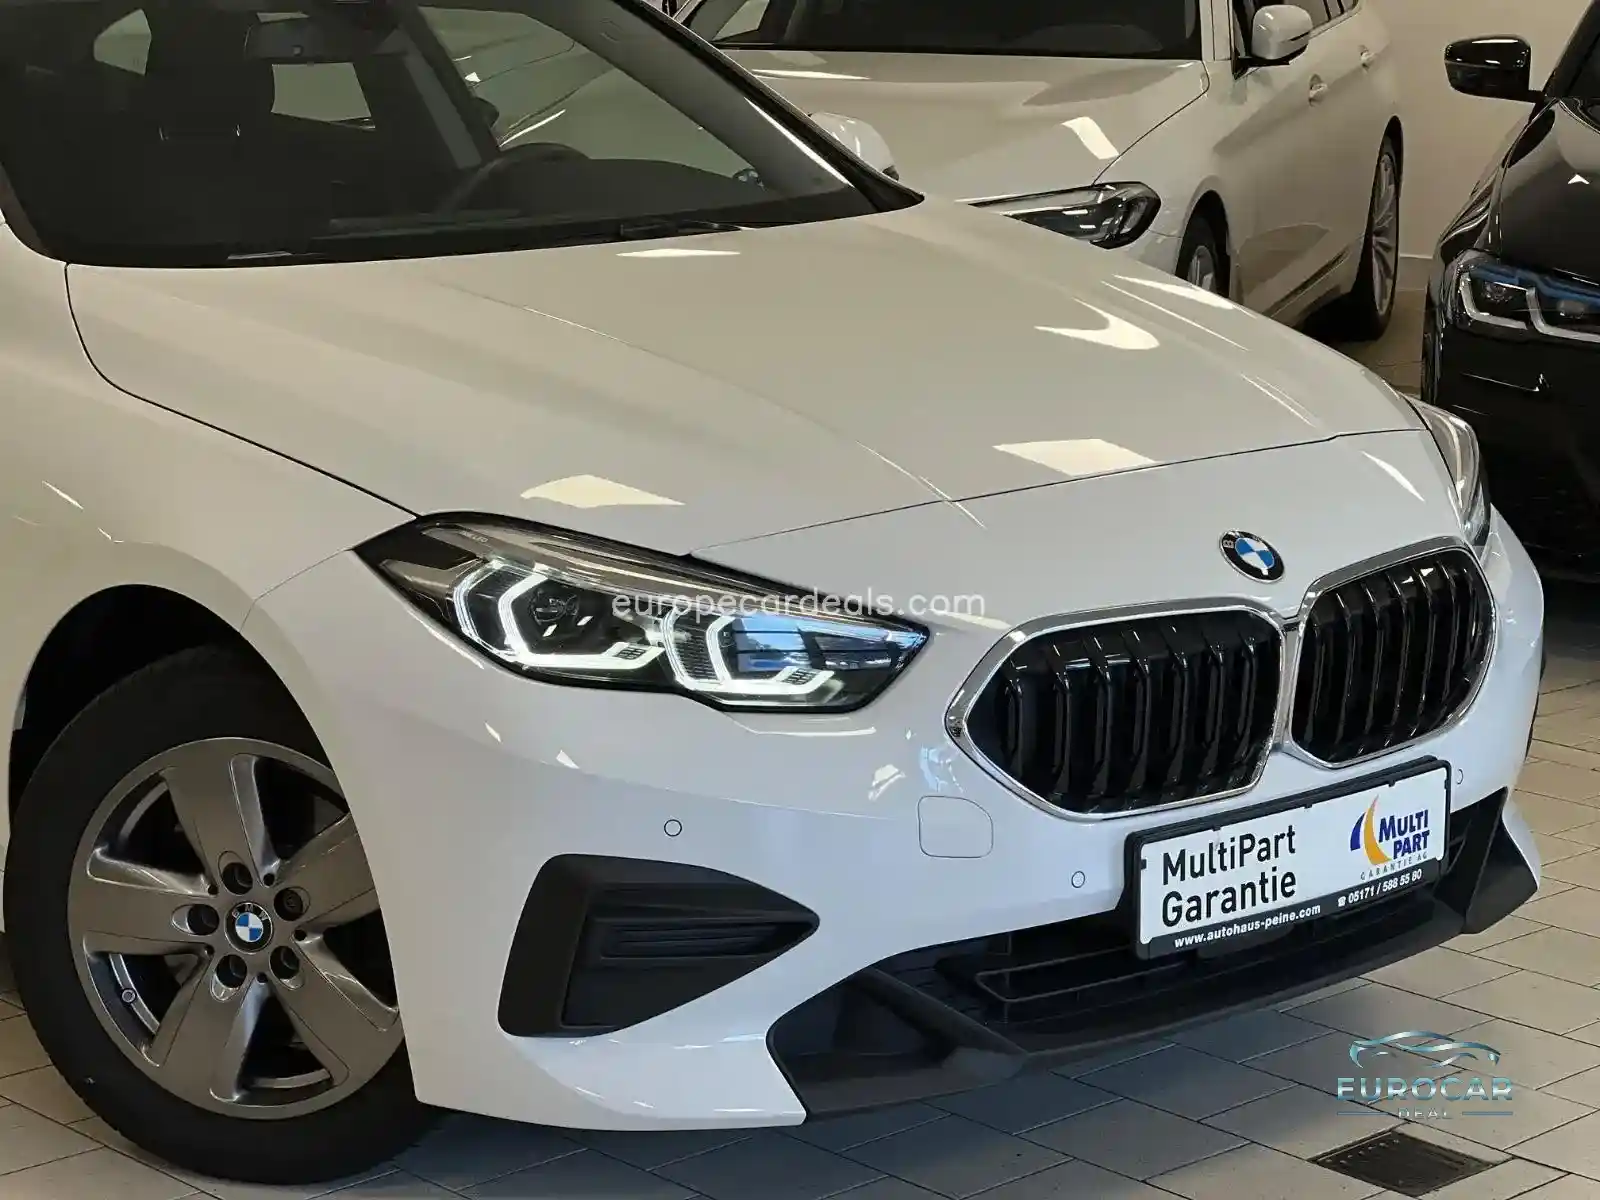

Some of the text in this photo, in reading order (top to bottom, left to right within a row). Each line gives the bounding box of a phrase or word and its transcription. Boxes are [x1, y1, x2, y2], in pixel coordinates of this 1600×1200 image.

[1379, 809, 1429, 843] MULTI
[1162, 824, 1296, 885] MultiPart
[1393, 829, 1430, 860] PART
[1360, 851, 1428, 881] GARANTIE AG
[1162, 866, 1296, 927] Garantie
[1348, 885, 1375, 904] 05171
[1382, 877, 1399, 892] 588
[1399, 872, 1411, 886] 55
[1411, 868, 1423, 882] 80
[1174, 903, 1321, 948] www.autohaus-peine.com
